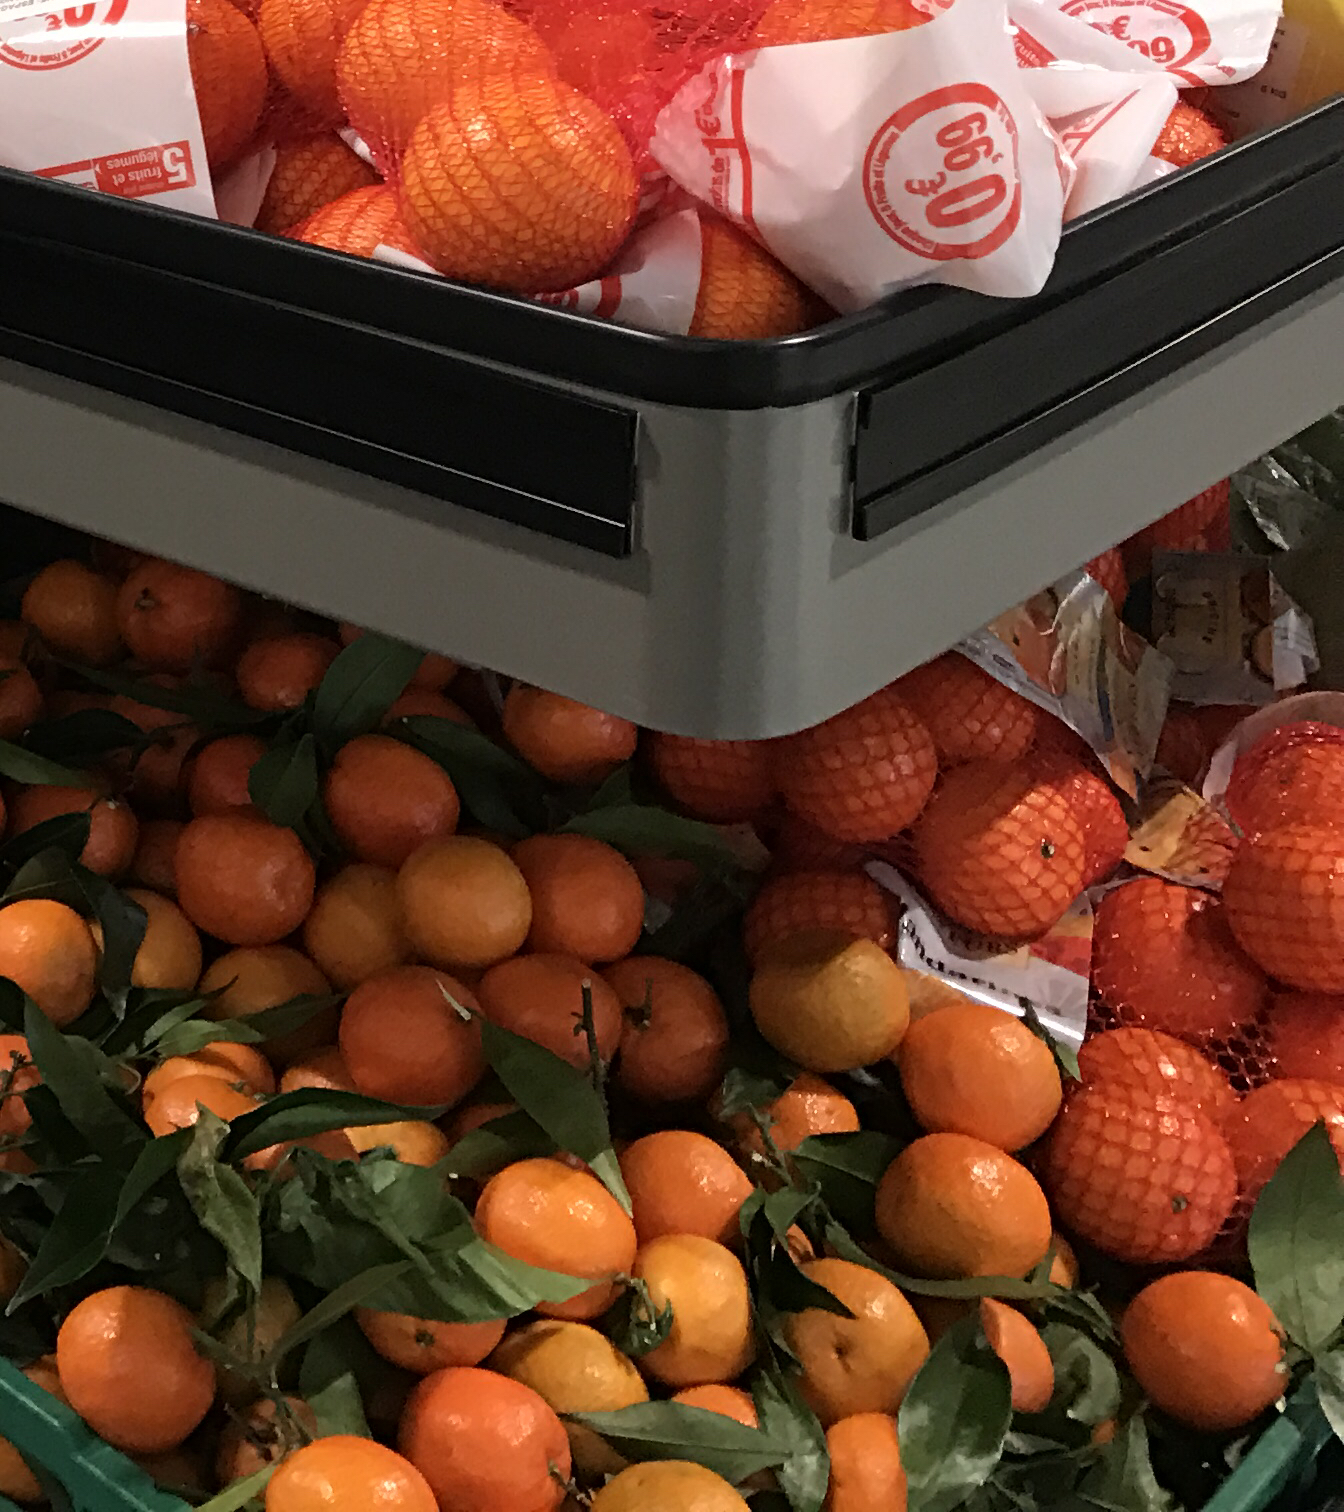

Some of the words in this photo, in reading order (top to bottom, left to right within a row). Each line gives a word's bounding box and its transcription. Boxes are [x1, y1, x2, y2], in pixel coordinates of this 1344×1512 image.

[106, 149, 160, 171] légumes
[163, 145, 188, 184] 5
[112, 172, 125, 187] et
[127, 165, 163, 182] fruits
